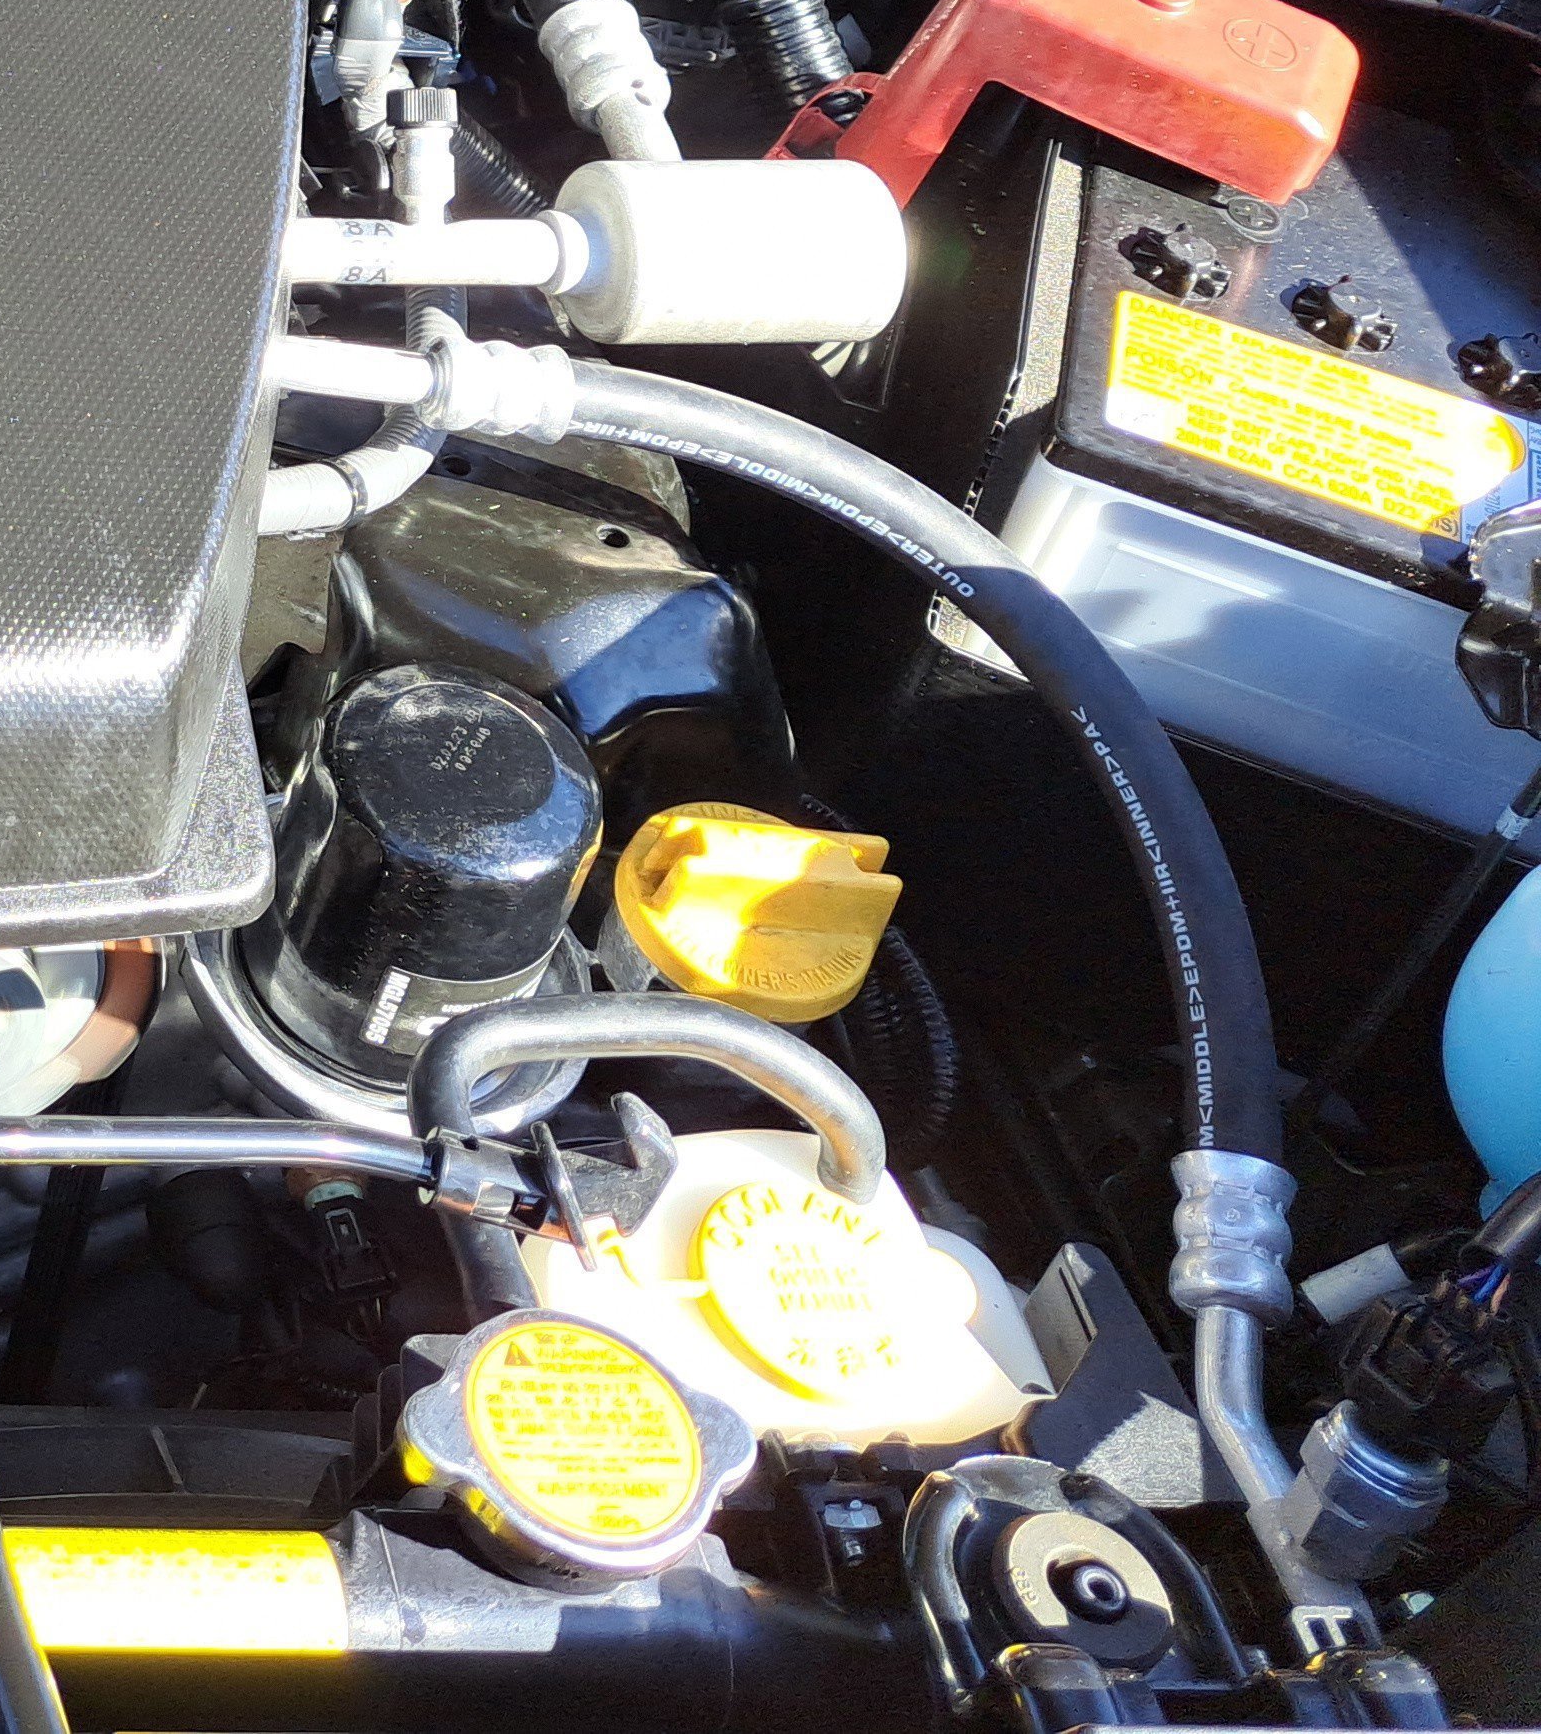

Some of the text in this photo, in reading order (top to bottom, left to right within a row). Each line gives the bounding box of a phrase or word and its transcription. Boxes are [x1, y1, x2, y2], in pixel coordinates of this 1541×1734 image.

[1128, 297, 1222, 336] DANGER
[1124, 345, 1214, 387] POISON
[1282, 462, 1327, 492] CCA
